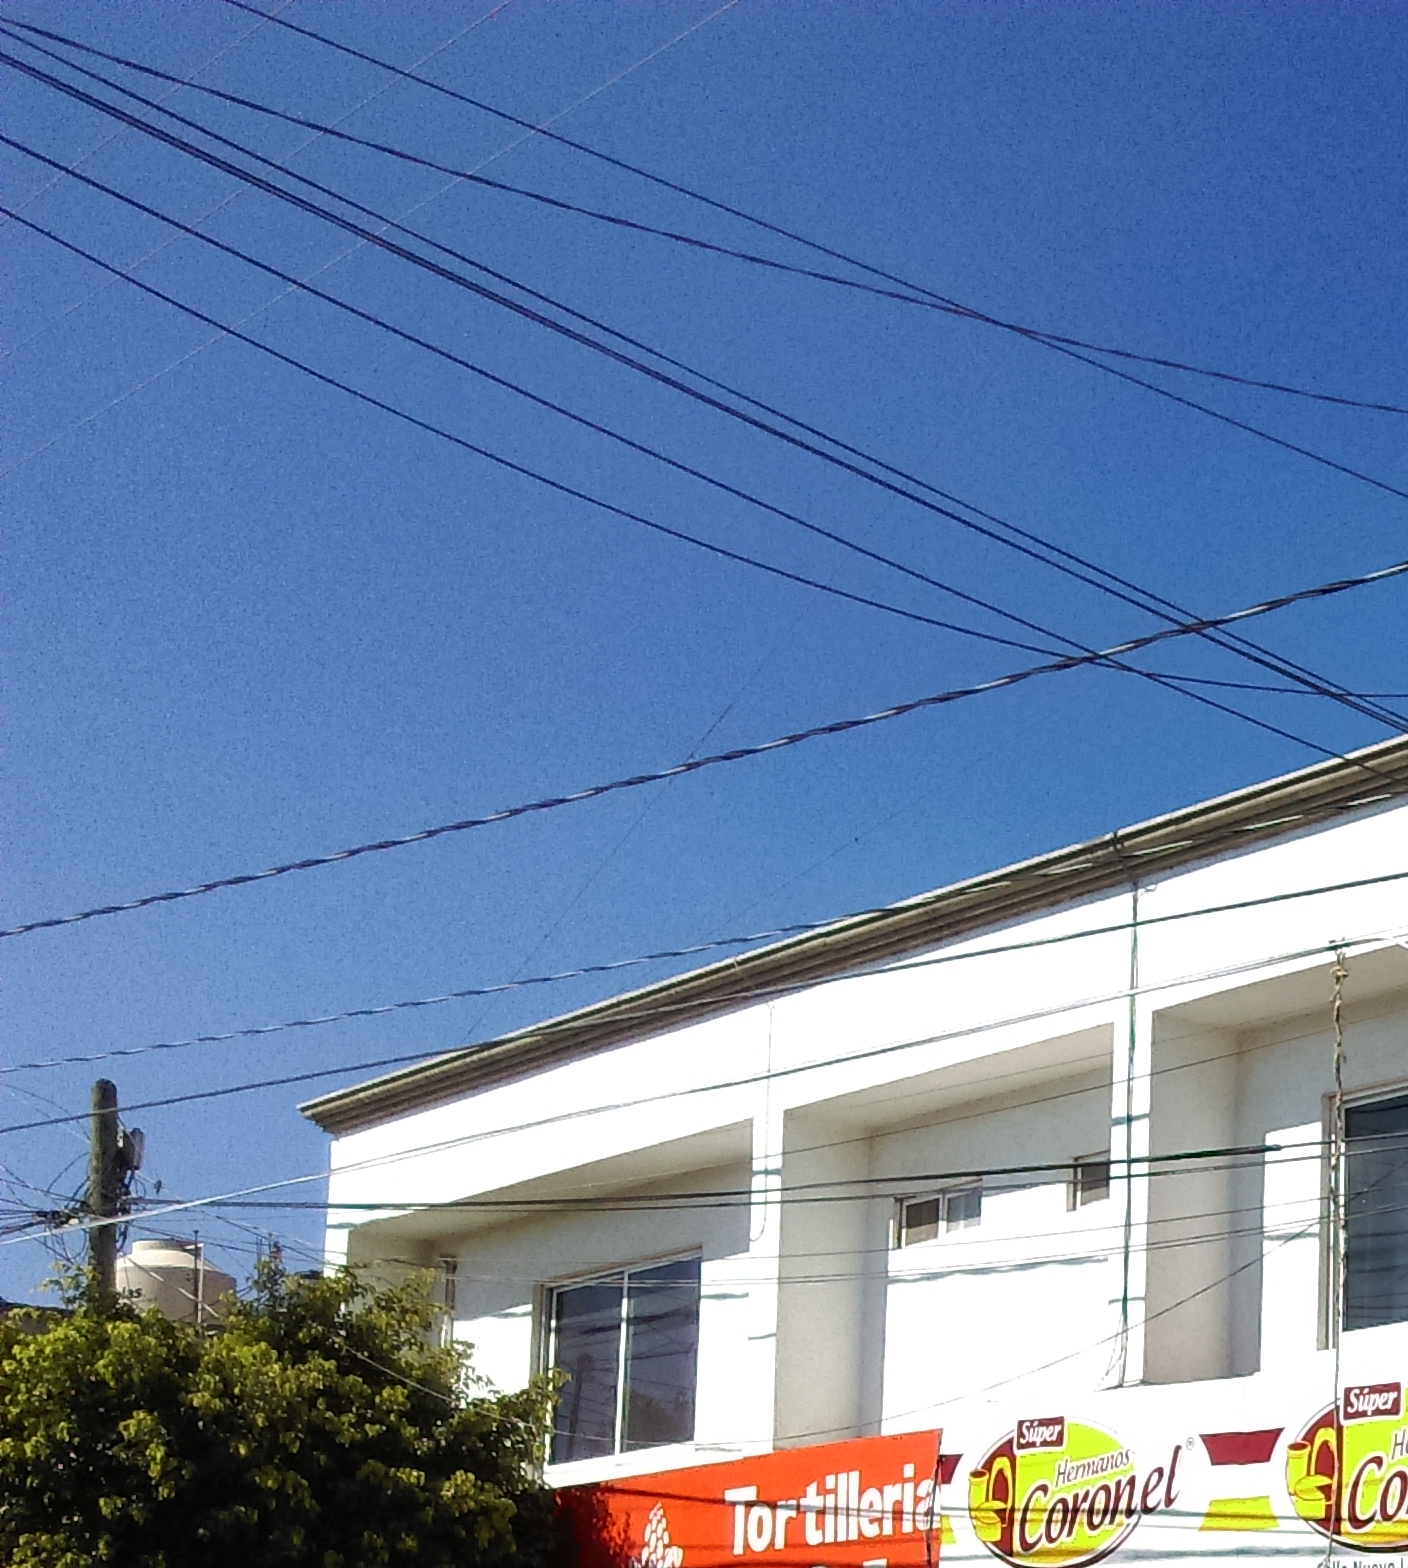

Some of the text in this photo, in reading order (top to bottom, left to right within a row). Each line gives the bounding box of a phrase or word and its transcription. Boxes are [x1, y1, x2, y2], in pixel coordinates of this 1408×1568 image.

[1346, 1387, 1398, 1414] Súper
[1019, 1422, 1062, 1444] Súper
[1056, 1449, 1131, 1488] Hermanos
[1018, 1445, 1182, 1552] Coronel
